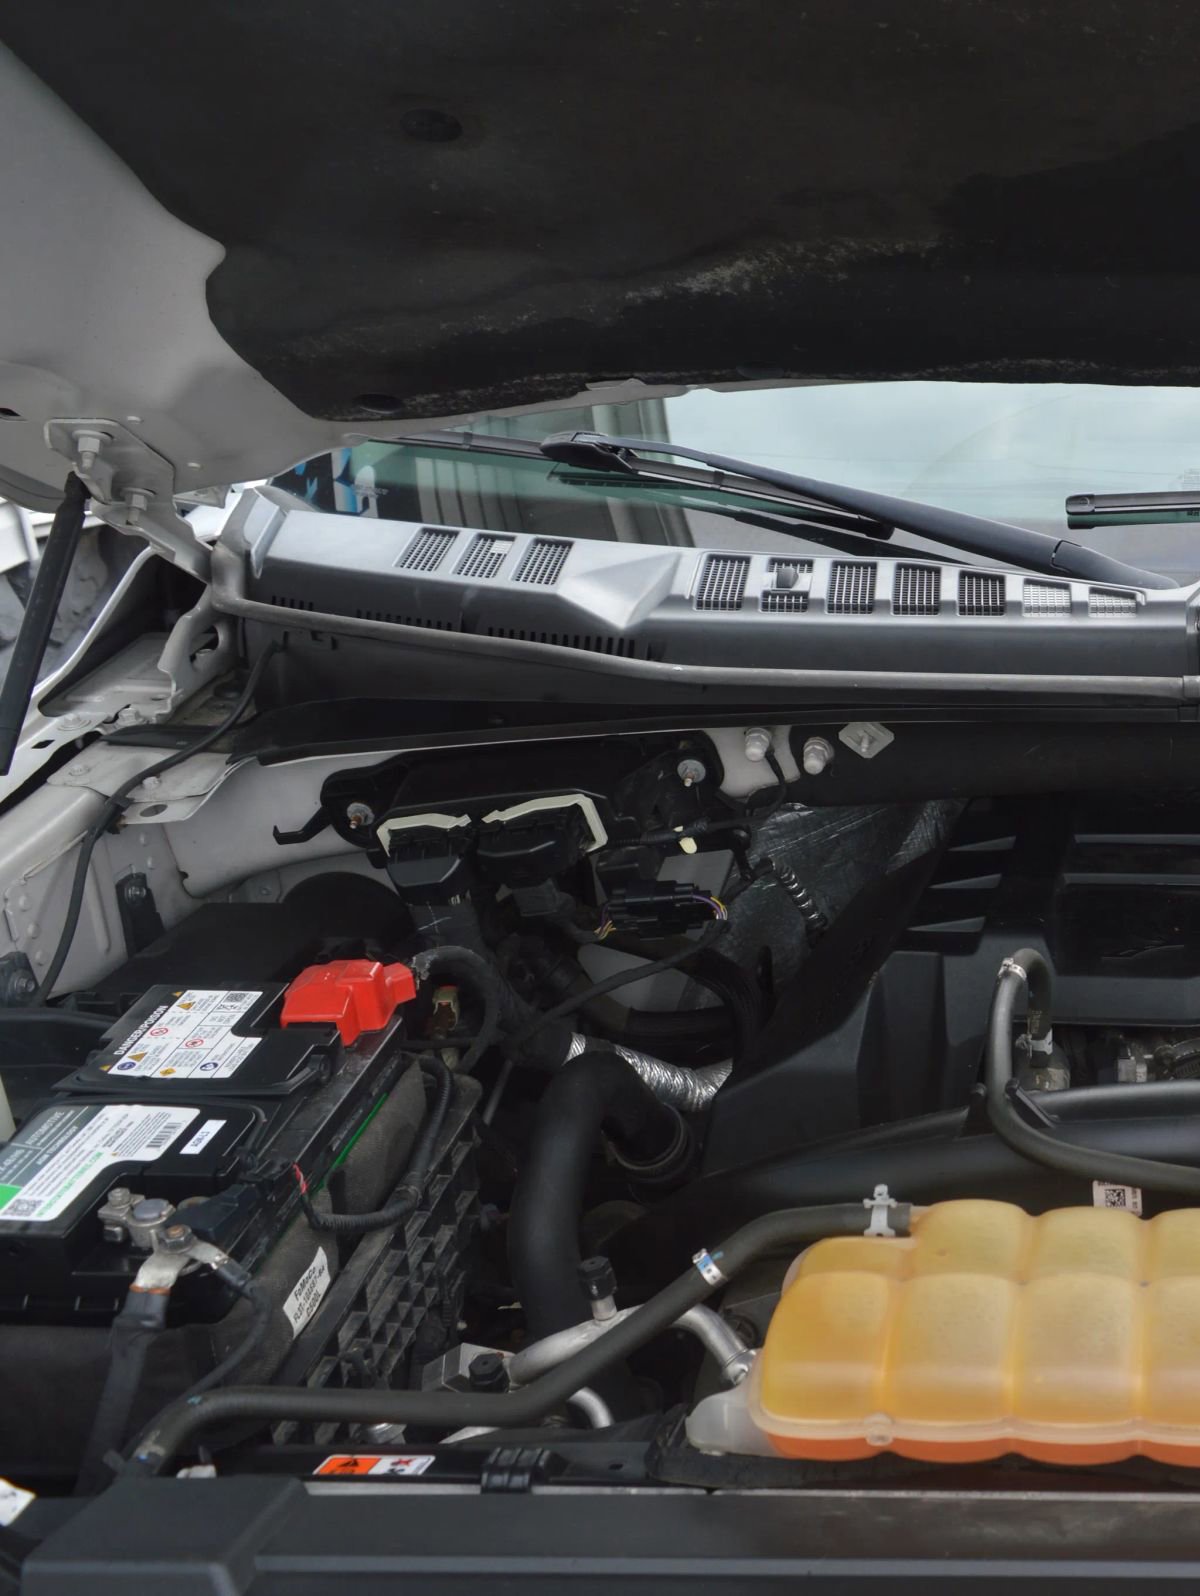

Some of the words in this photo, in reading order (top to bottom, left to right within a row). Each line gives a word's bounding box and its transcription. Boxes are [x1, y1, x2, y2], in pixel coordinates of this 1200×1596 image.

[113, 1004, 169, 1056] DANGER/POISON
[25, 1111, 65, 1145] AUTOMOTIVE
[294, 1266, 316, 1301] FoMoCo
